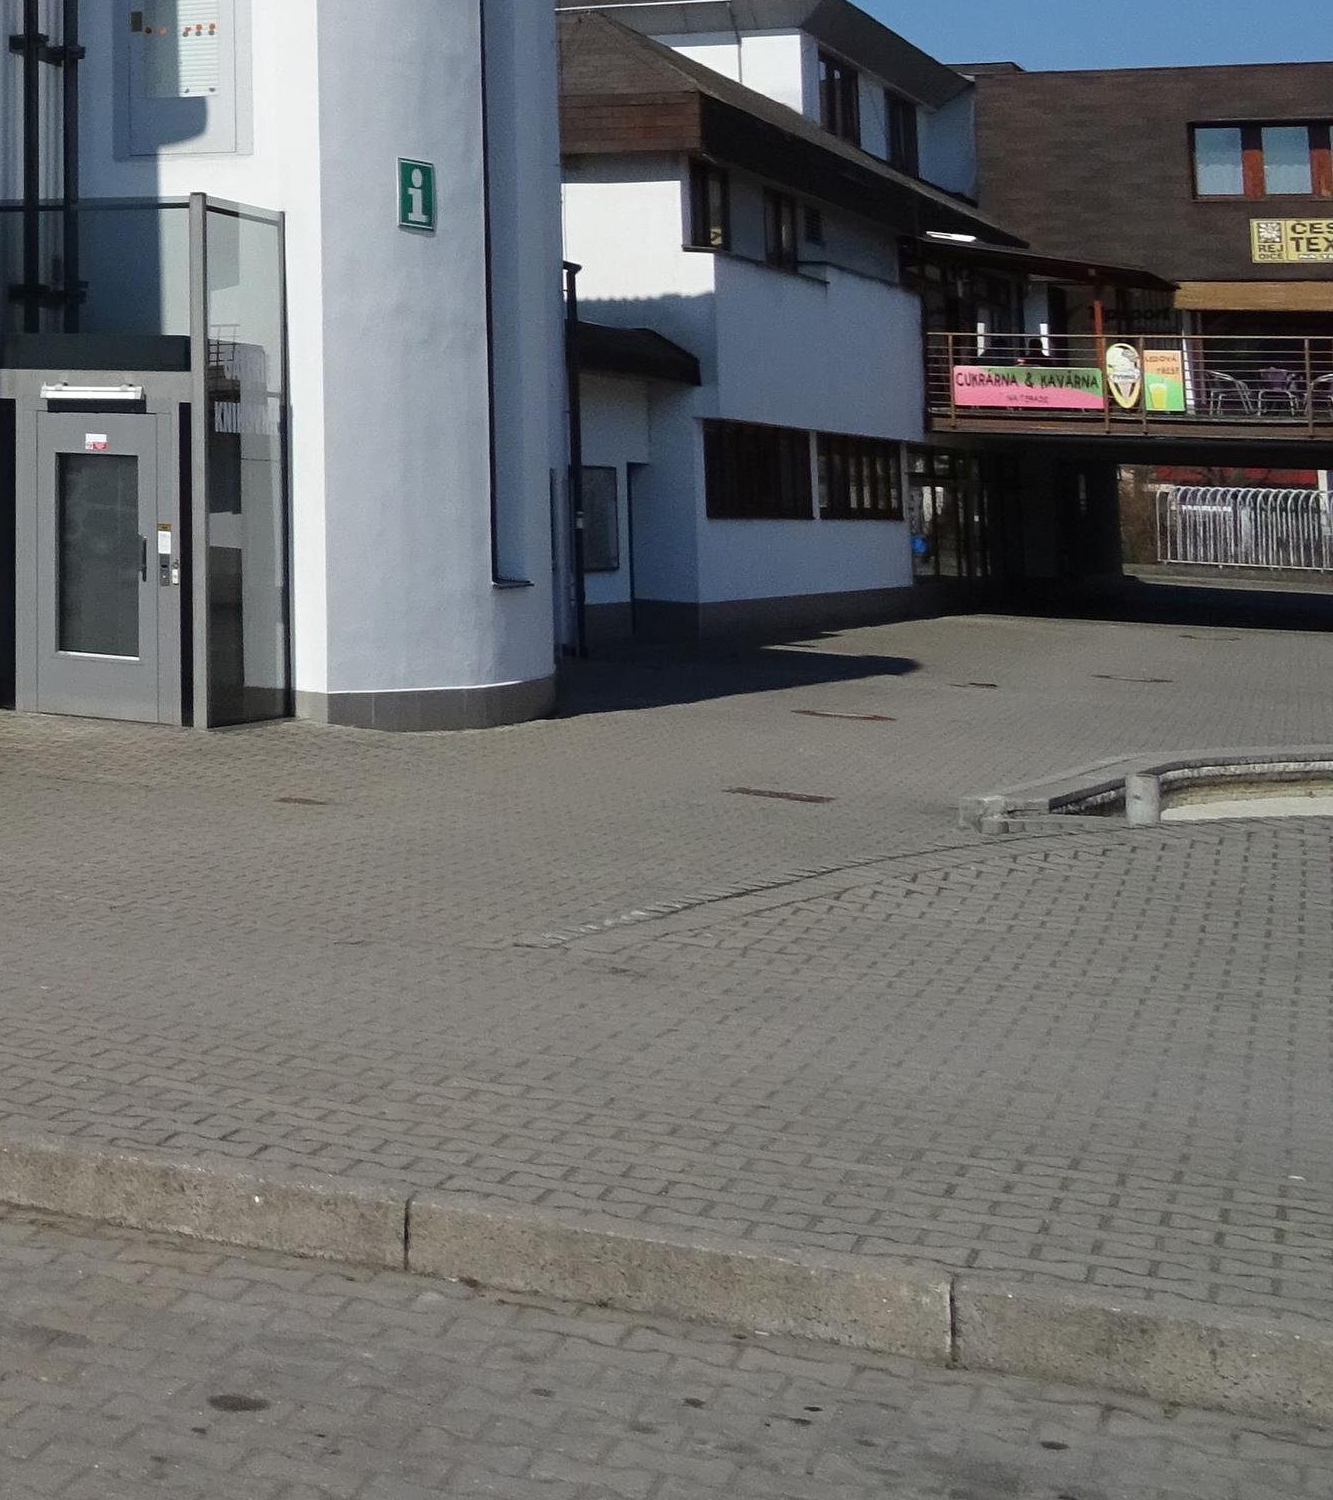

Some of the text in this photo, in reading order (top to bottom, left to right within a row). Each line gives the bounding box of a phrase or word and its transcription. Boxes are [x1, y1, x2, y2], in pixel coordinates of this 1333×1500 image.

[955, 368, 1100, 389] CUKRÁRNA & KAVÁRNA
